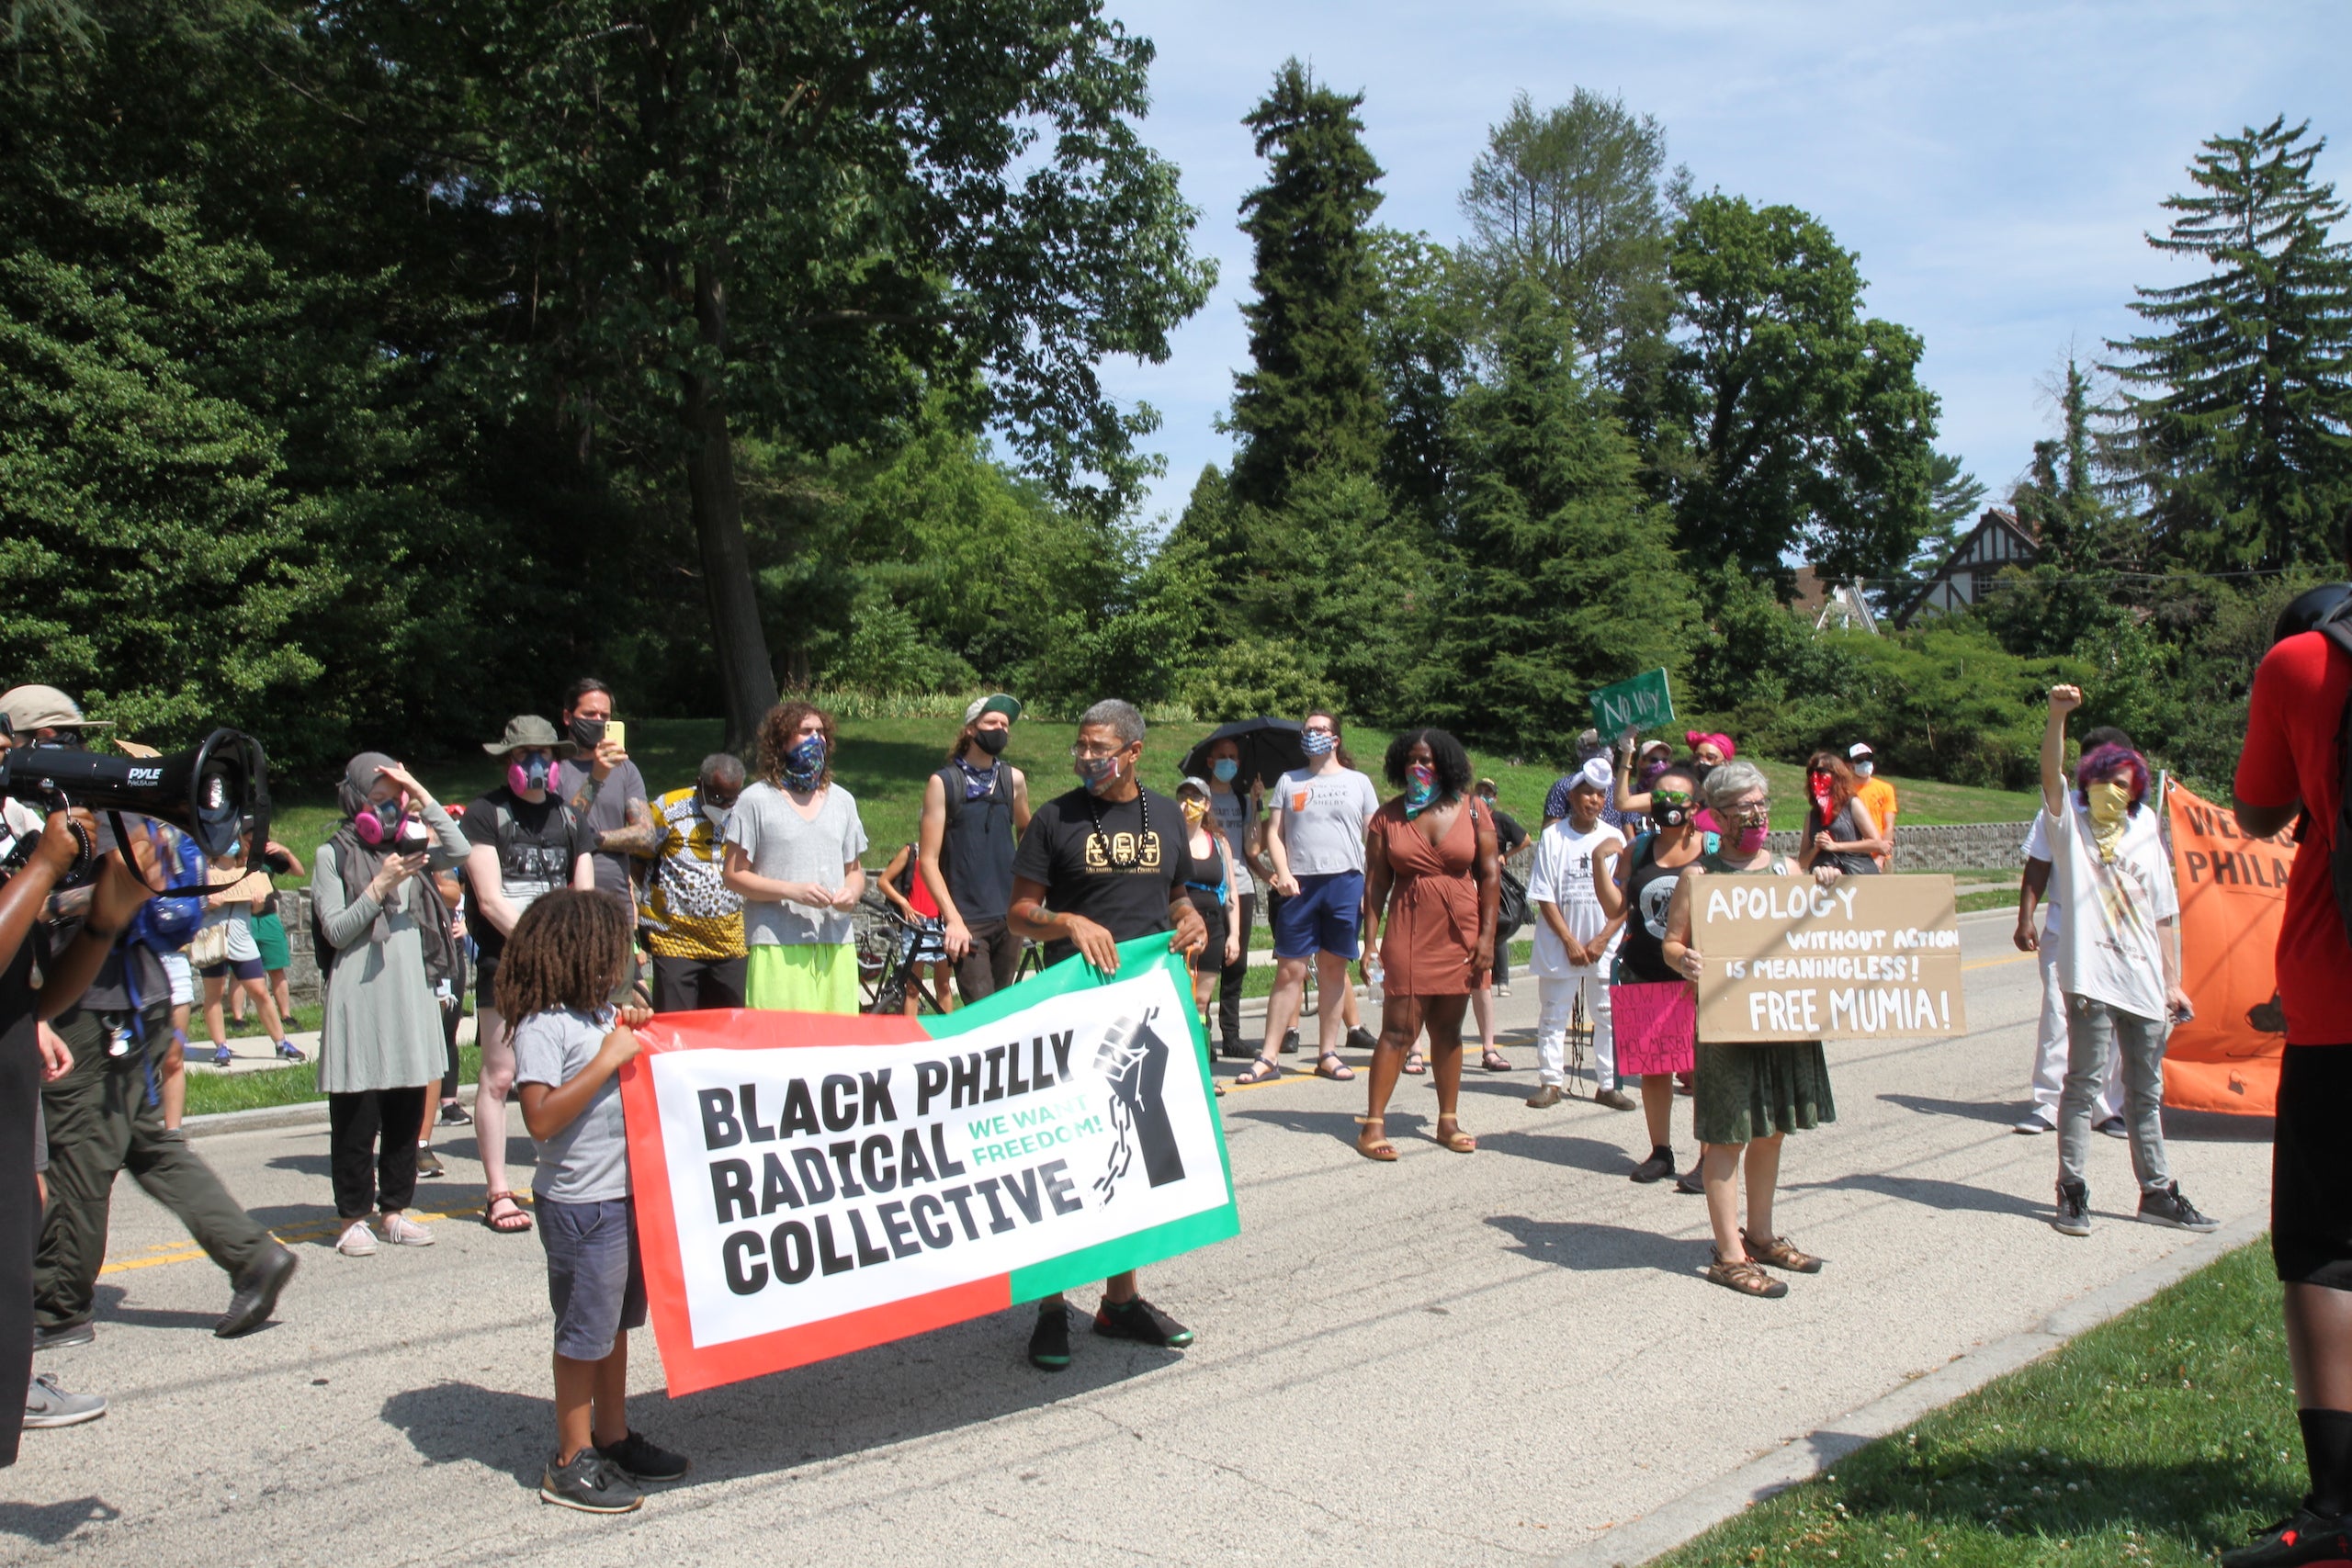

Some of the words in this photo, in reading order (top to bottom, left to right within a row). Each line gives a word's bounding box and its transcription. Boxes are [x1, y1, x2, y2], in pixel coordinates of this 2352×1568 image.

[129, 768, 163, 780] PYLE
[2185, 851, 2294, 889] PHILA
[1706, 885, 1857, 923] APOLOGY
[1786, 930, 1886, 951] WITHOUT
[1894, 928, 1960, 949] ACTION
[1725, 961, 1746, 979] IS
[1753, 955, 1920, 982] MEANINGLESS!
[1612, 983, 1653, 1008] KNOW
[1749, 988, 1821, 1032] FREE
[1829, 987, 1951, 1032] MUMIA!
[1619, 1033, 1694, 1057] HOLMESBU
[697, 1067, 898, 1150] BLACK
[913, 1029, 1075, 1116] PHILLY
[967, 1114, 1010, 1140] WE
[1012, 1094, 1088, 1129] WANT
[971, 1115, 1103, 1167] FREEDOM!
[709, 1122, 965, 1224] RADICAL
[722, 1158, 1083, 1295] COLLECTIVE
